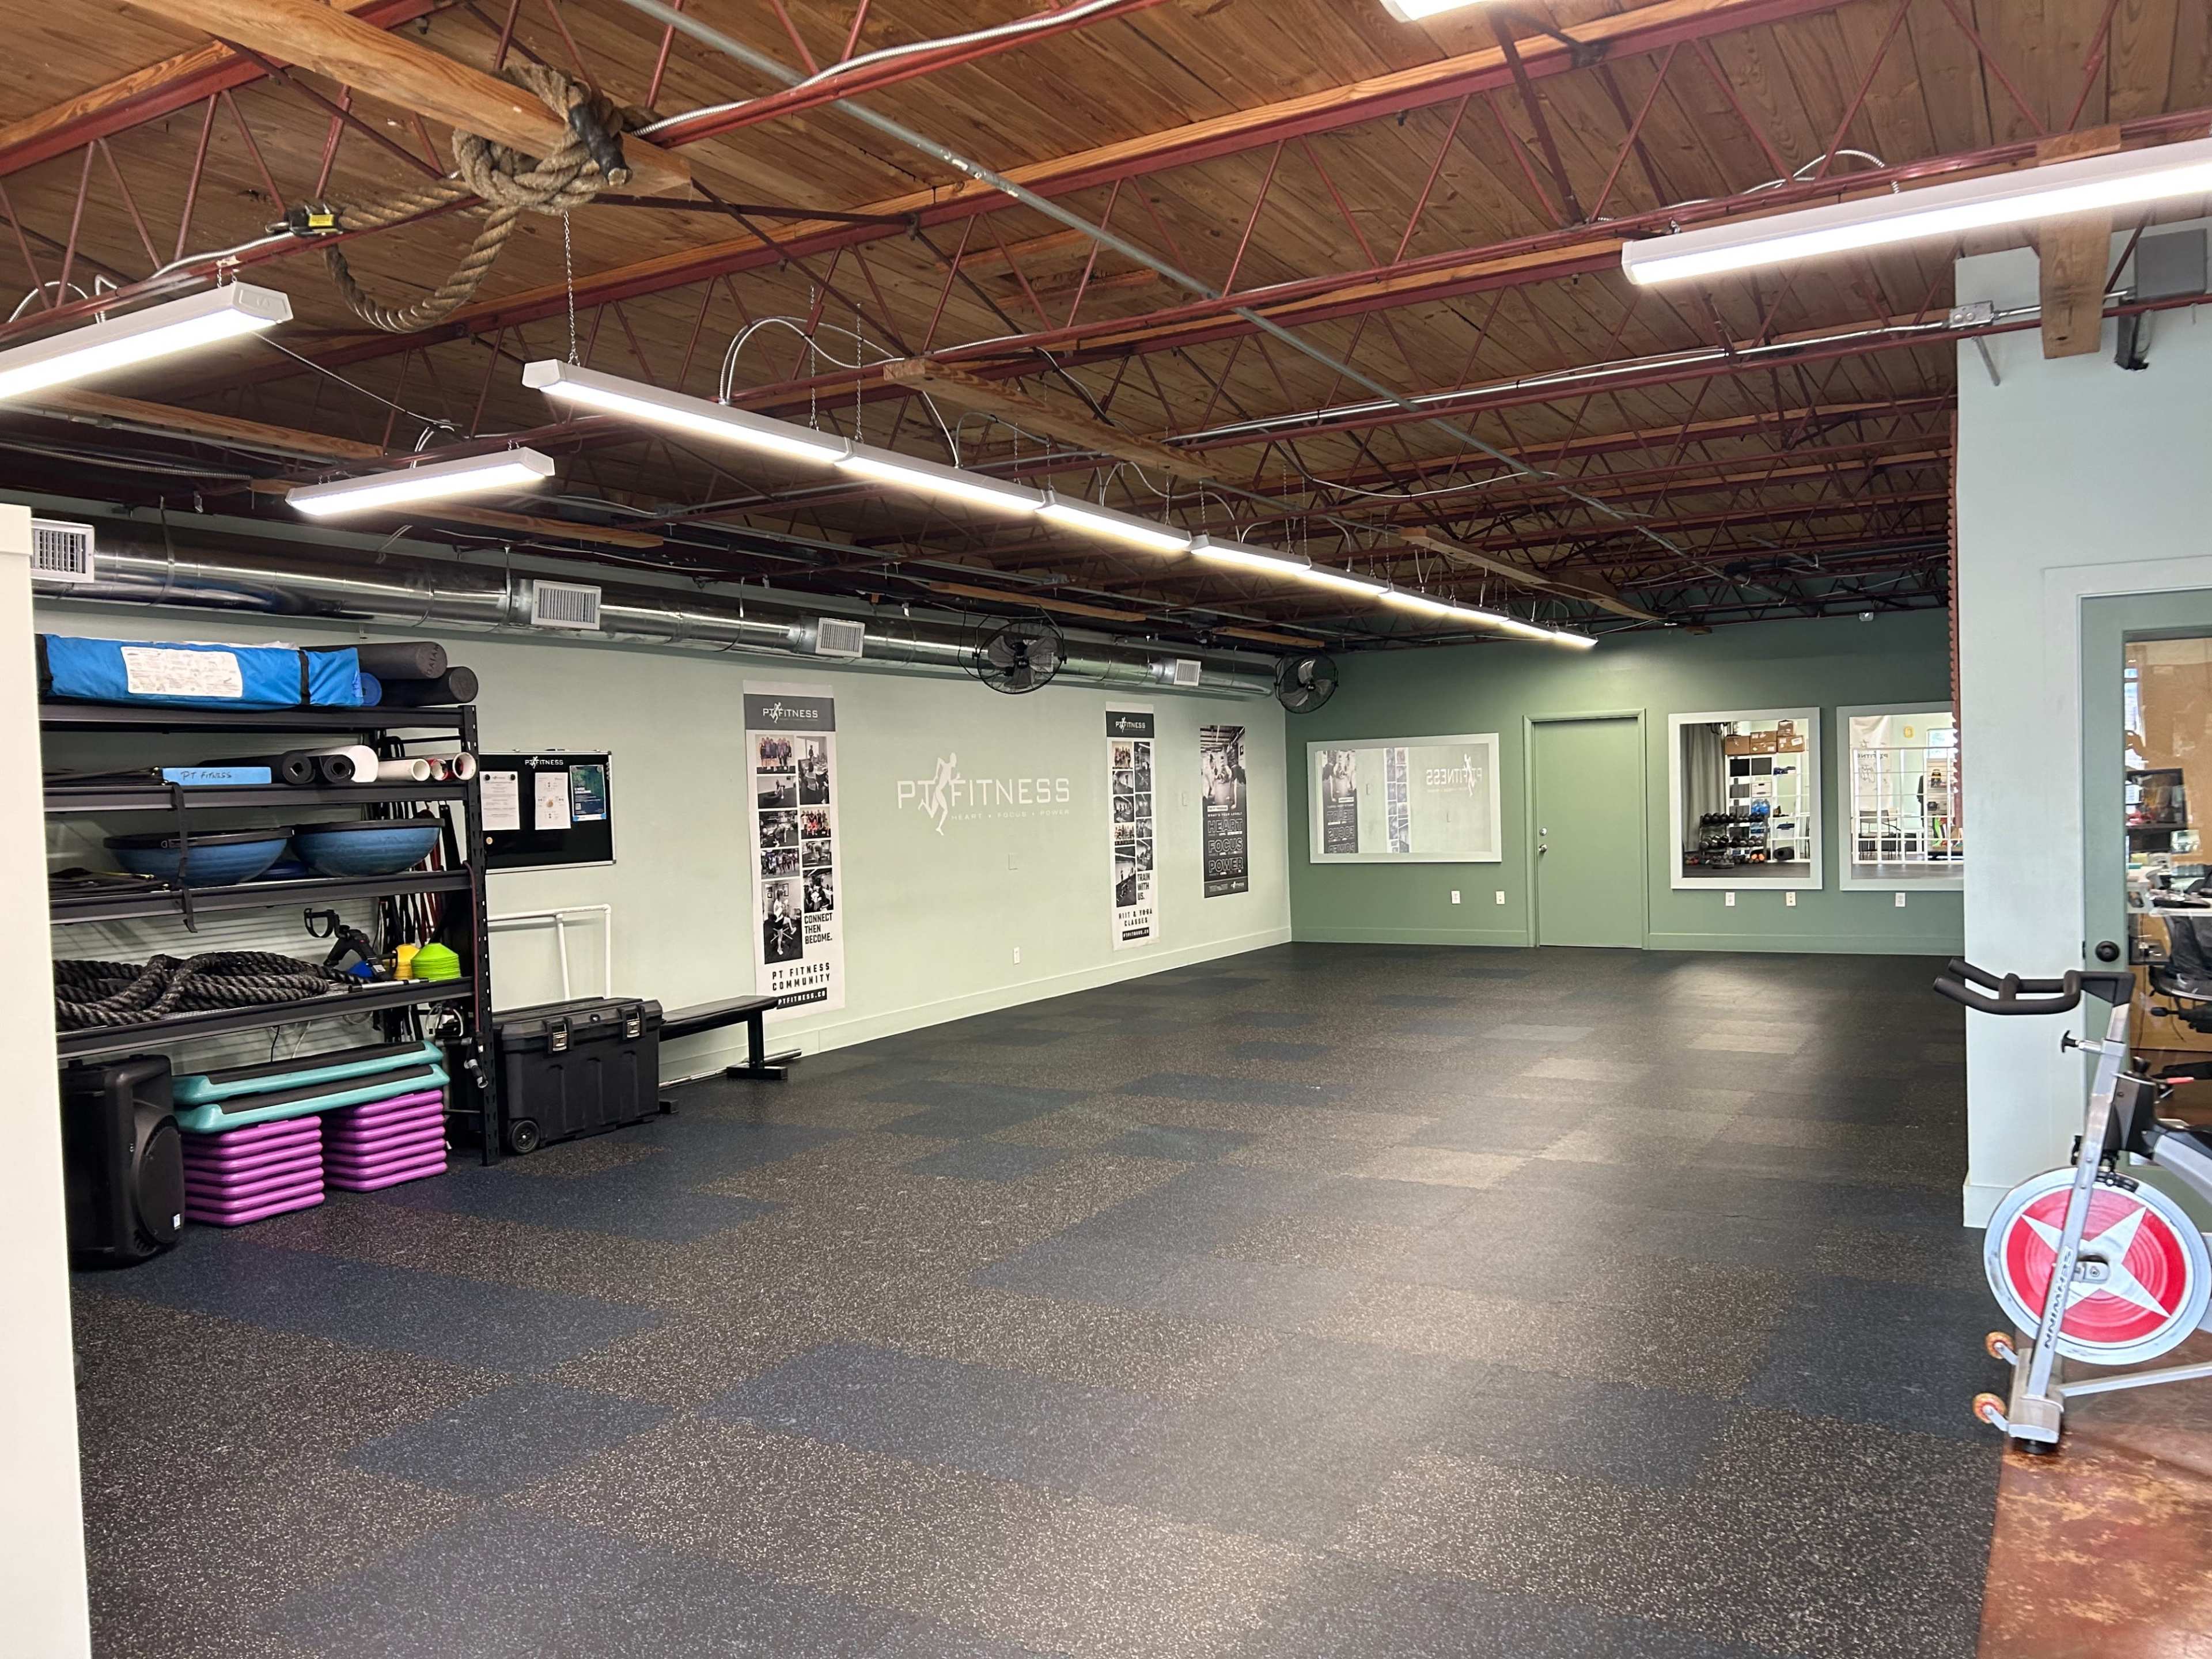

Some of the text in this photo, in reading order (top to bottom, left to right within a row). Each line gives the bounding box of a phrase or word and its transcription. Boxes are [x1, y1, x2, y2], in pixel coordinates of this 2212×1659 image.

[779, 709, 818, 718] FITNESS
[180, 771, 232, 781] PT FITNESS
[949, 778, 1070, 807] FITNESS
[951, 813, 982, 821] HEART
[1207, 818, 1243, 834] HEART
[1208, 838, 1243, 853] FOCUS
[1209, 857, 1244, 873] POWER
[1137, 873, 1150, 881] TRAIN
[1138, 882, 1150, 891] WITH
[1139, 908, 1152, 916] YOGA
[804, 912, 833, 924] CONNECT
[1124, 917, 1148, 927] CLASSES
[805, 924, 821, 934] THEN
[805, 933, 832, 944] BECOME.
[772, 963, 830, 980] PT FITNESS
[772, 973, 830, 991] COMMUNITY
